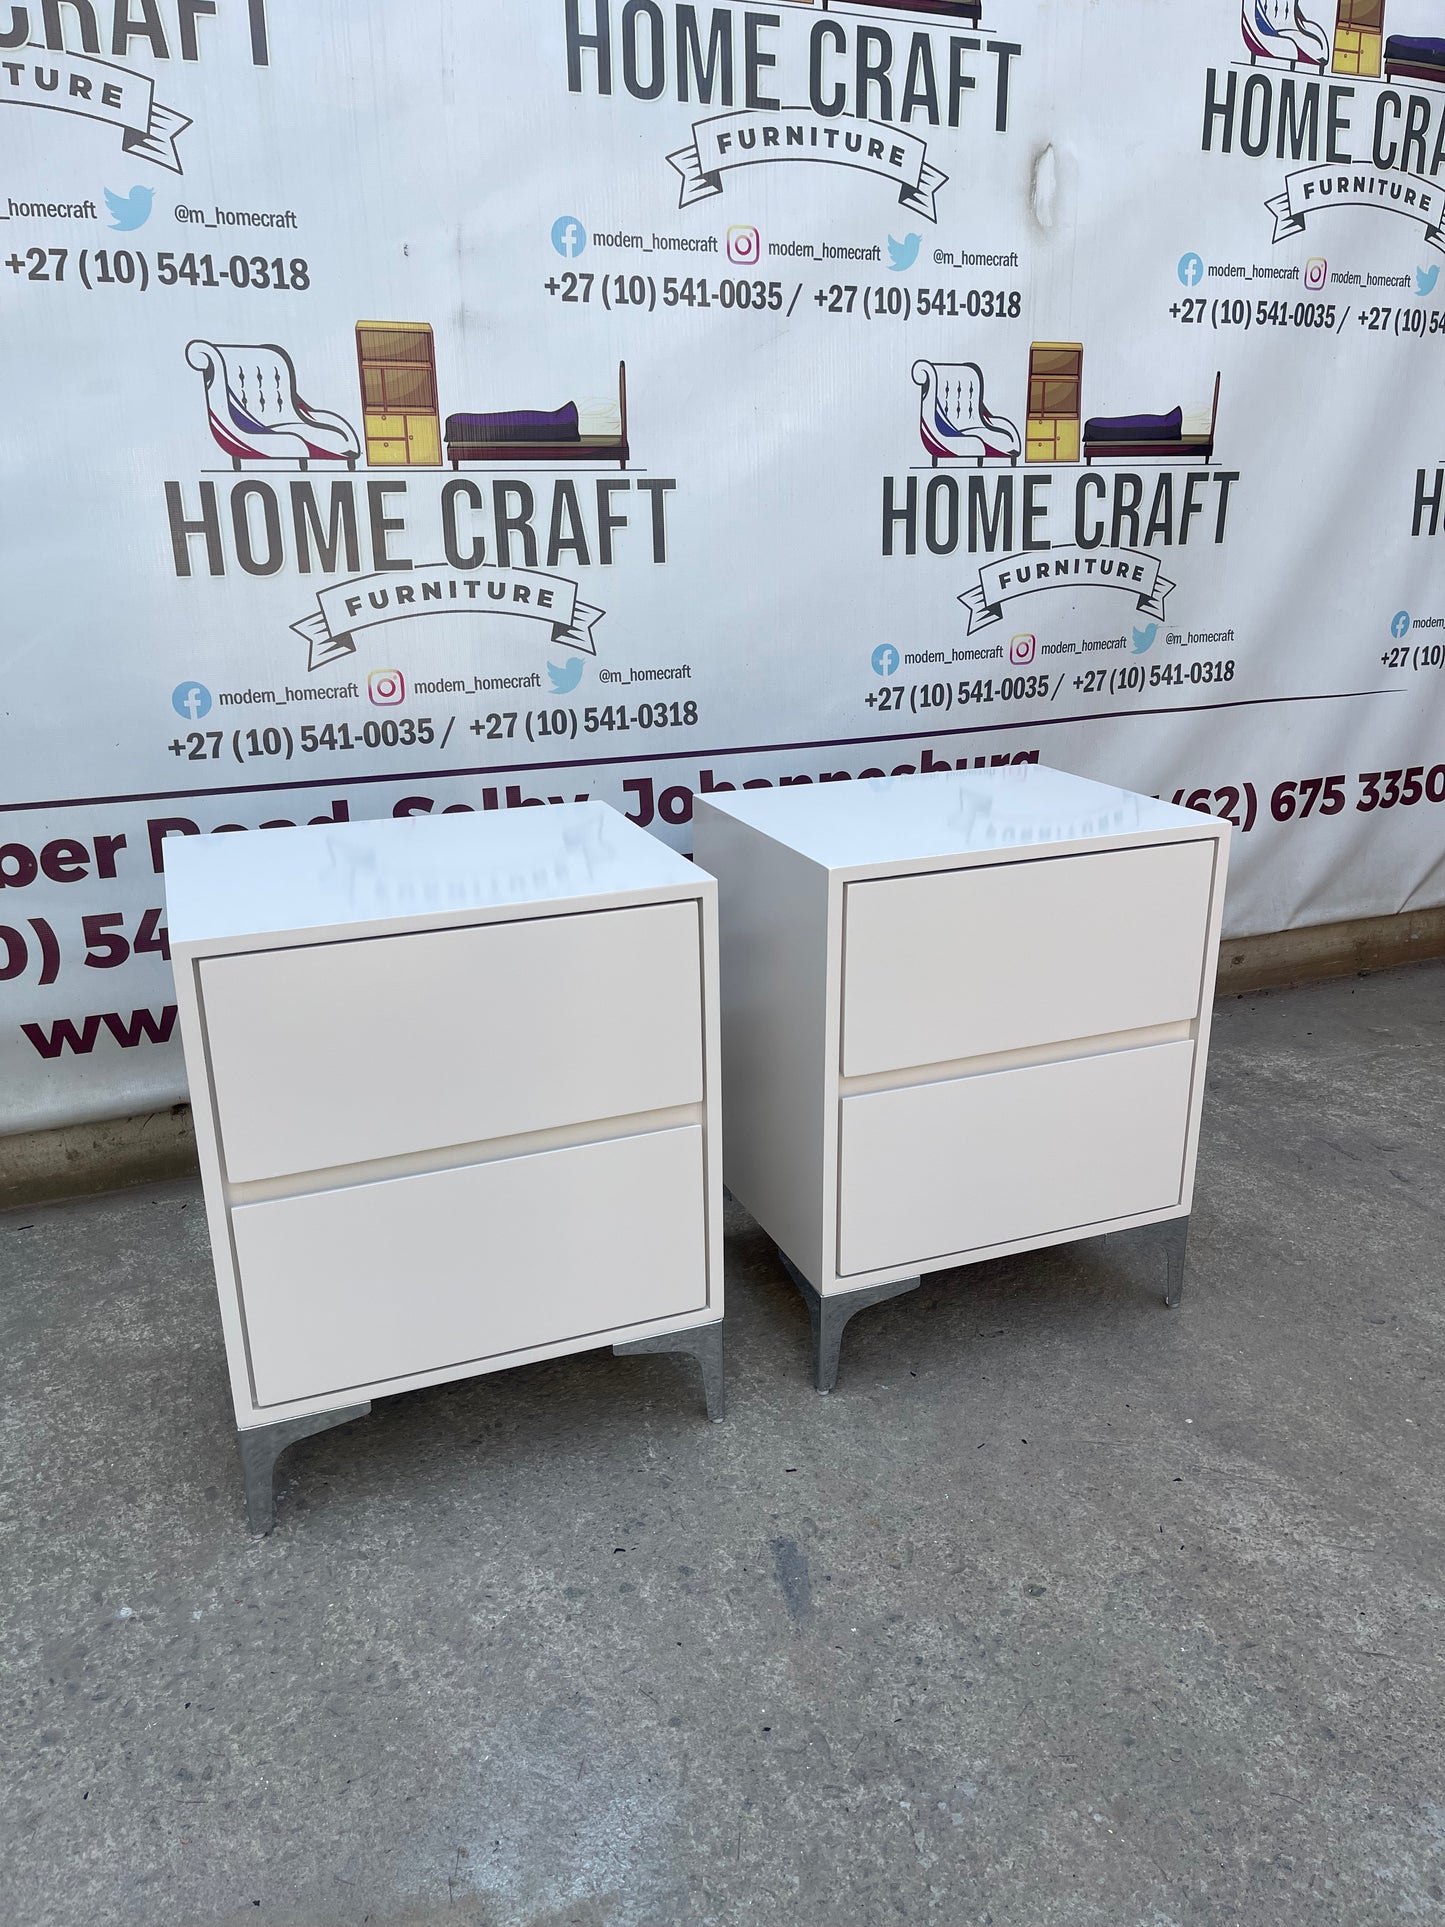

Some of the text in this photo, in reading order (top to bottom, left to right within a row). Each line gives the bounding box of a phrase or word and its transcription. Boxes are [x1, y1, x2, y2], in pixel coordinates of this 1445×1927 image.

[564, 0, 1022, 132] HOME CRAFT
[1202, 68, 1355, 164] HOME
[717, 126, 906, 168] FURNITURE
[1304, 176, 1432, 212] FURNITURE
[175, 205, 297, 228] @m_homecraft
[5, 248, 310, 291] +27 (10) 541-0318
[934, 249, 1018, 267] @m_homecraft
[545, 272, 1021, 320] +27 (10) 541-0035 / +27 (10) 541-0318
[1169, 298, 1207, 323] +27
[1212, 299, 1251, 330] (10)
[1256, 301, 1335, 328] 541-0035
[1337, 306, 1350, 334] /
[1358, 307, 1391, 330] +27
[1395, 309, 1426, 337] (10)
[882, 471, 1240, 555] HOME CRAFT
[1412, 468, 1445, 536] H
[165, 478, 676, 576] HOME CRAFT
[999, 558, 1144, 589] FURNITURE
[346, 580, 554, 617] FURNITURE
[1166, 629, 1234, 646] @m_homecraft
[1381, 647, 1410, 668] +27
[599, 665, 691, 685] @m_homecraft
[865, 660, 1235, 713] +27 (10) 541-0035 / +27 (10) 541-0318
[168, 701, 698, 763] +27 (10) 541-0035 / +27 (10) 541-0318
[1271, 775, 1345, 822] 675
[1357, 764, 1445, 812] 3350
